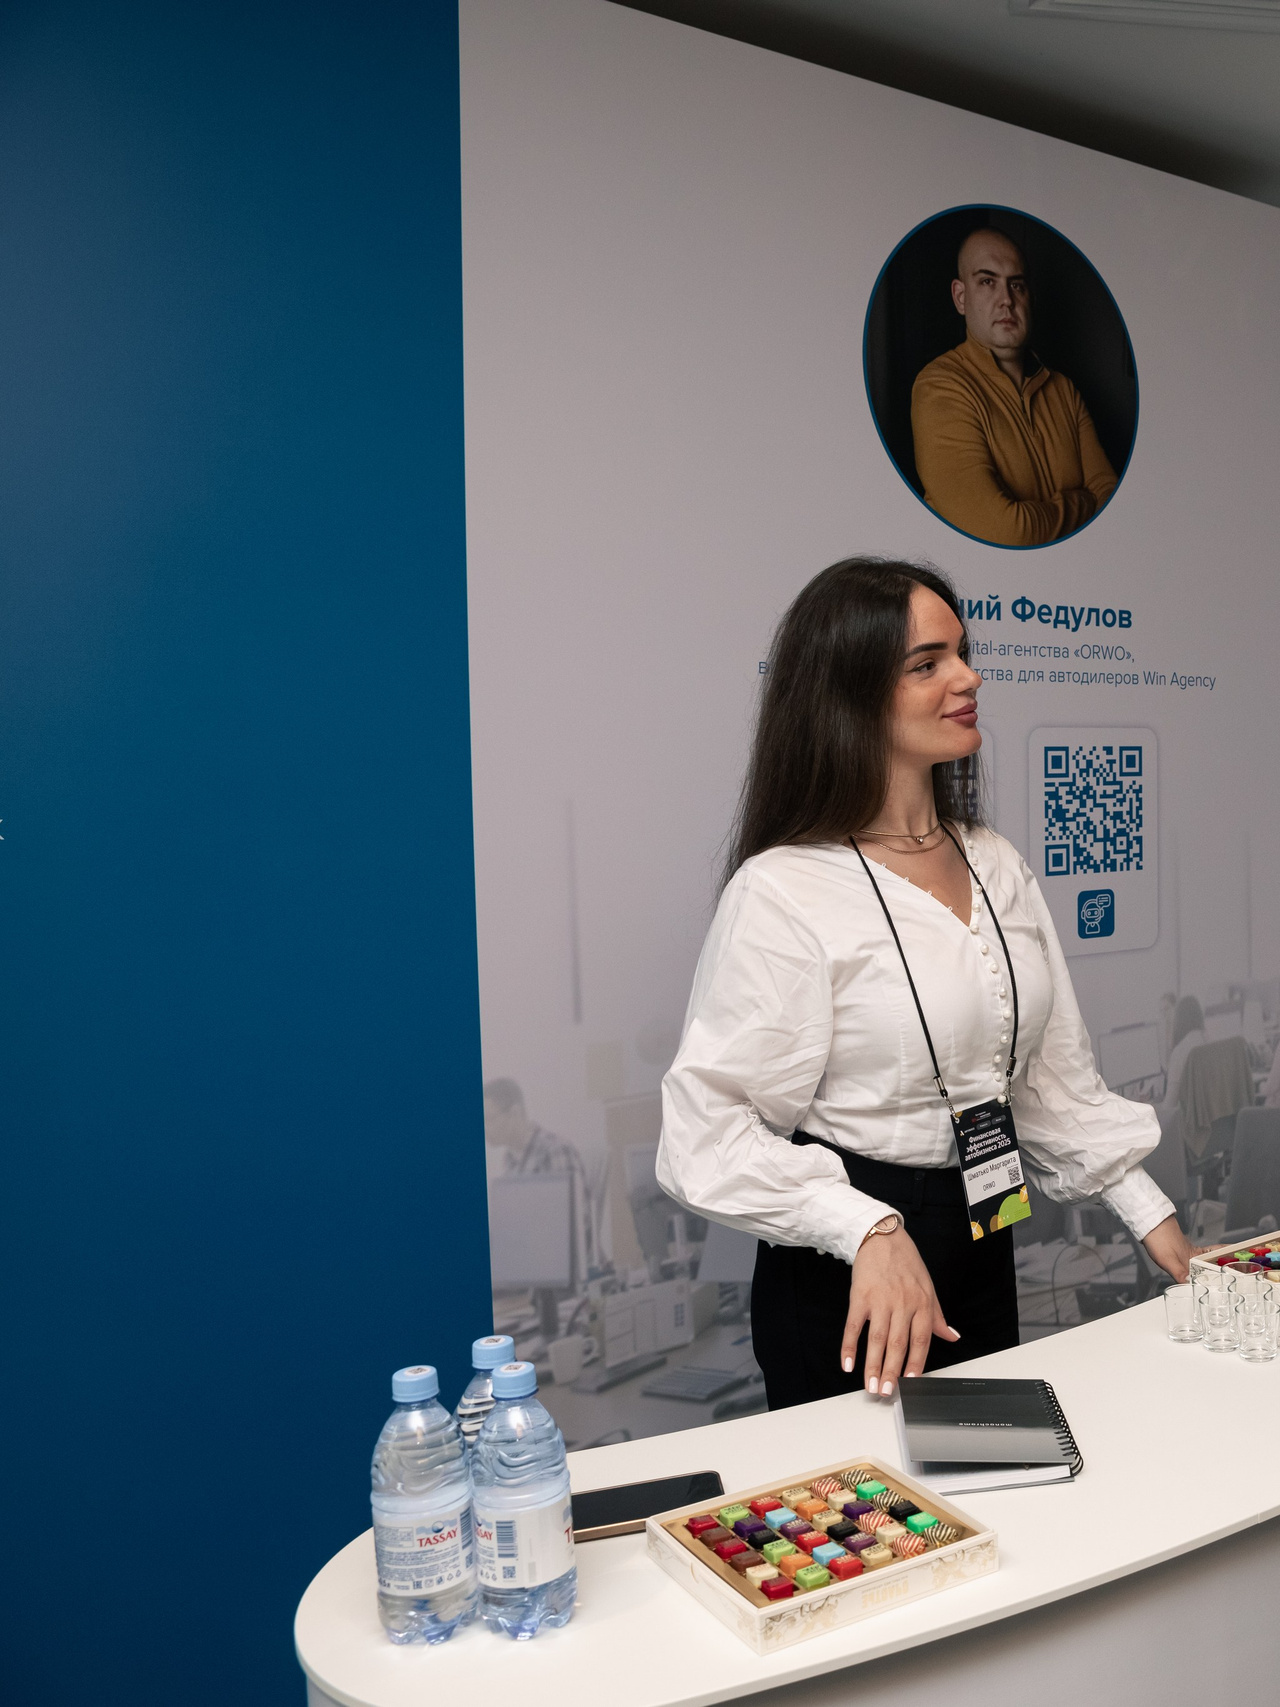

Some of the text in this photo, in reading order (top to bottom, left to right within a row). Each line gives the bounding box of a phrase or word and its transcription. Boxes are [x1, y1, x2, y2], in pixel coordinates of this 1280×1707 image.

[1010, 595, 1133, 633] Федулов
[971, 639, 1136, 664] ital-агентства «ORWO»,
[1017, 669, 1044, 685] для
[1048, 670, 1140, 687] автодилеров
[1142, 670, 1167, 686] Win
[1169, 672, 1217, 691] Agency
[997, 1137, 1012, 1149] 2025
[989, 1156, 1017, 1172] Маргарита
[416, 1527, 459, 1548] TASSAY
